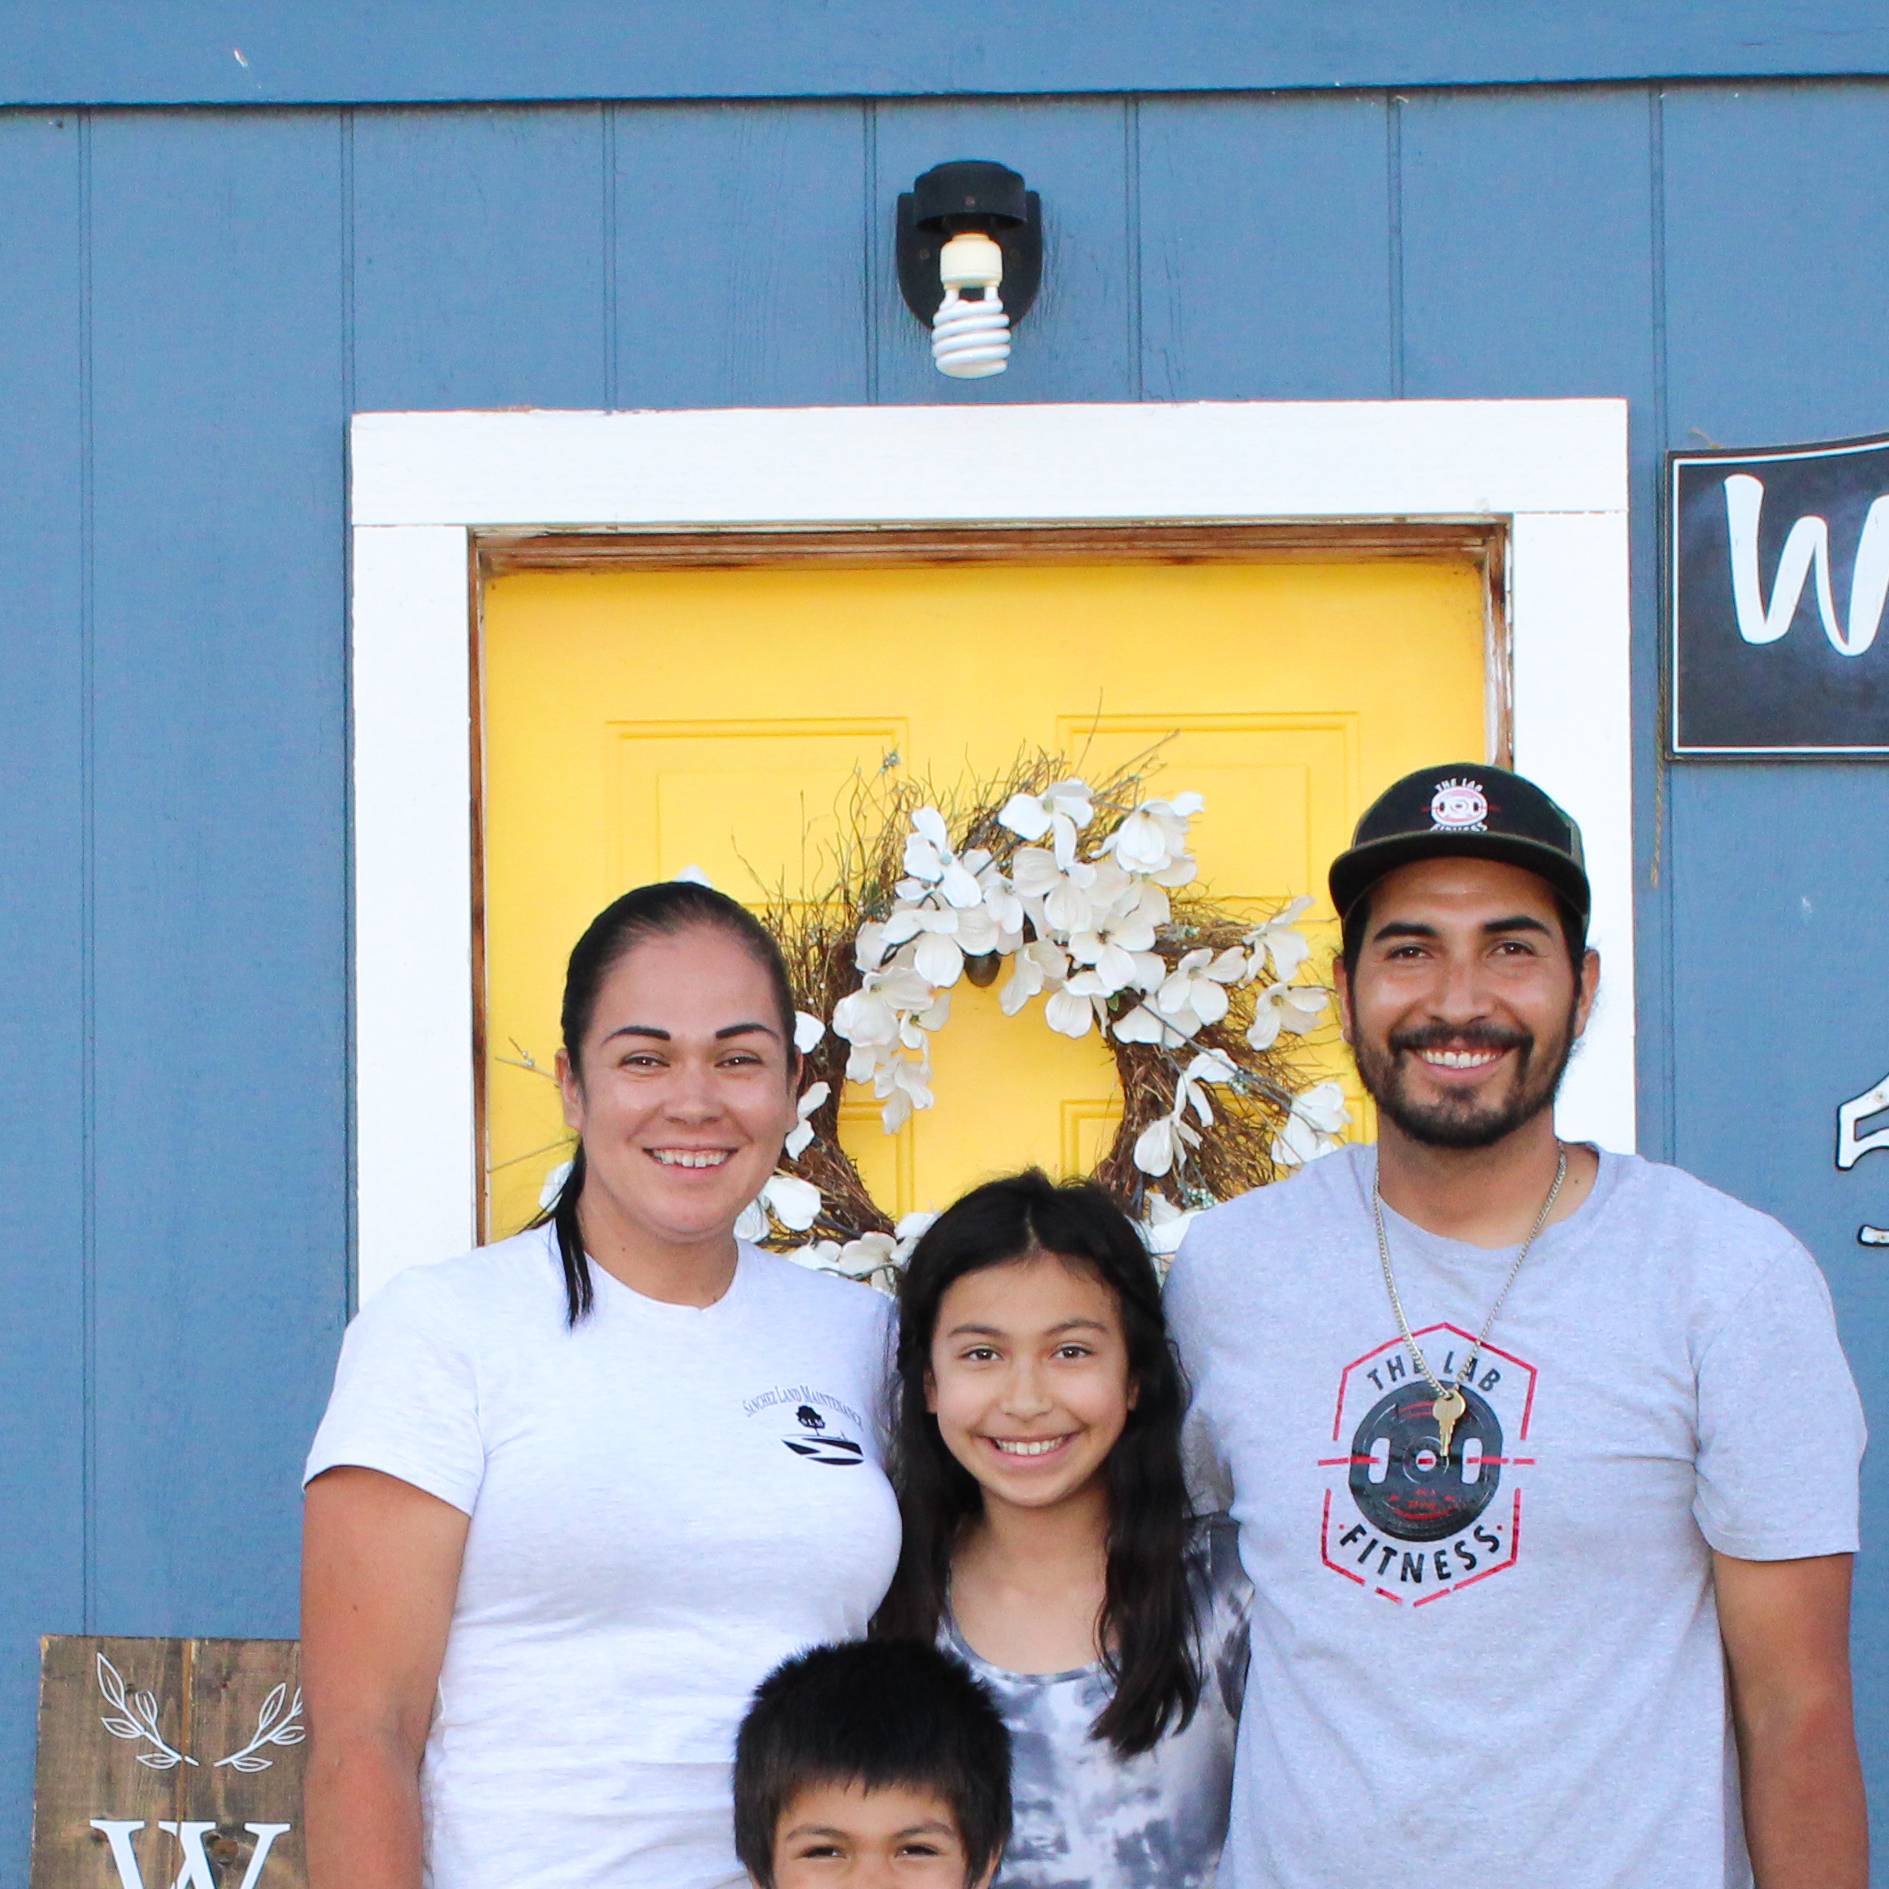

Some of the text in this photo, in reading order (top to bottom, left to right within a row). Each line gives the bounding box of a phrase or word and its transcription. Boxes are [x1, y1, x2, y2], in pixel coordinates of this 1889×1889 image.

[1367, 1350, 1501, 1392] THE LAB
[1339, 1524, 1500, 1583] FITNESS
